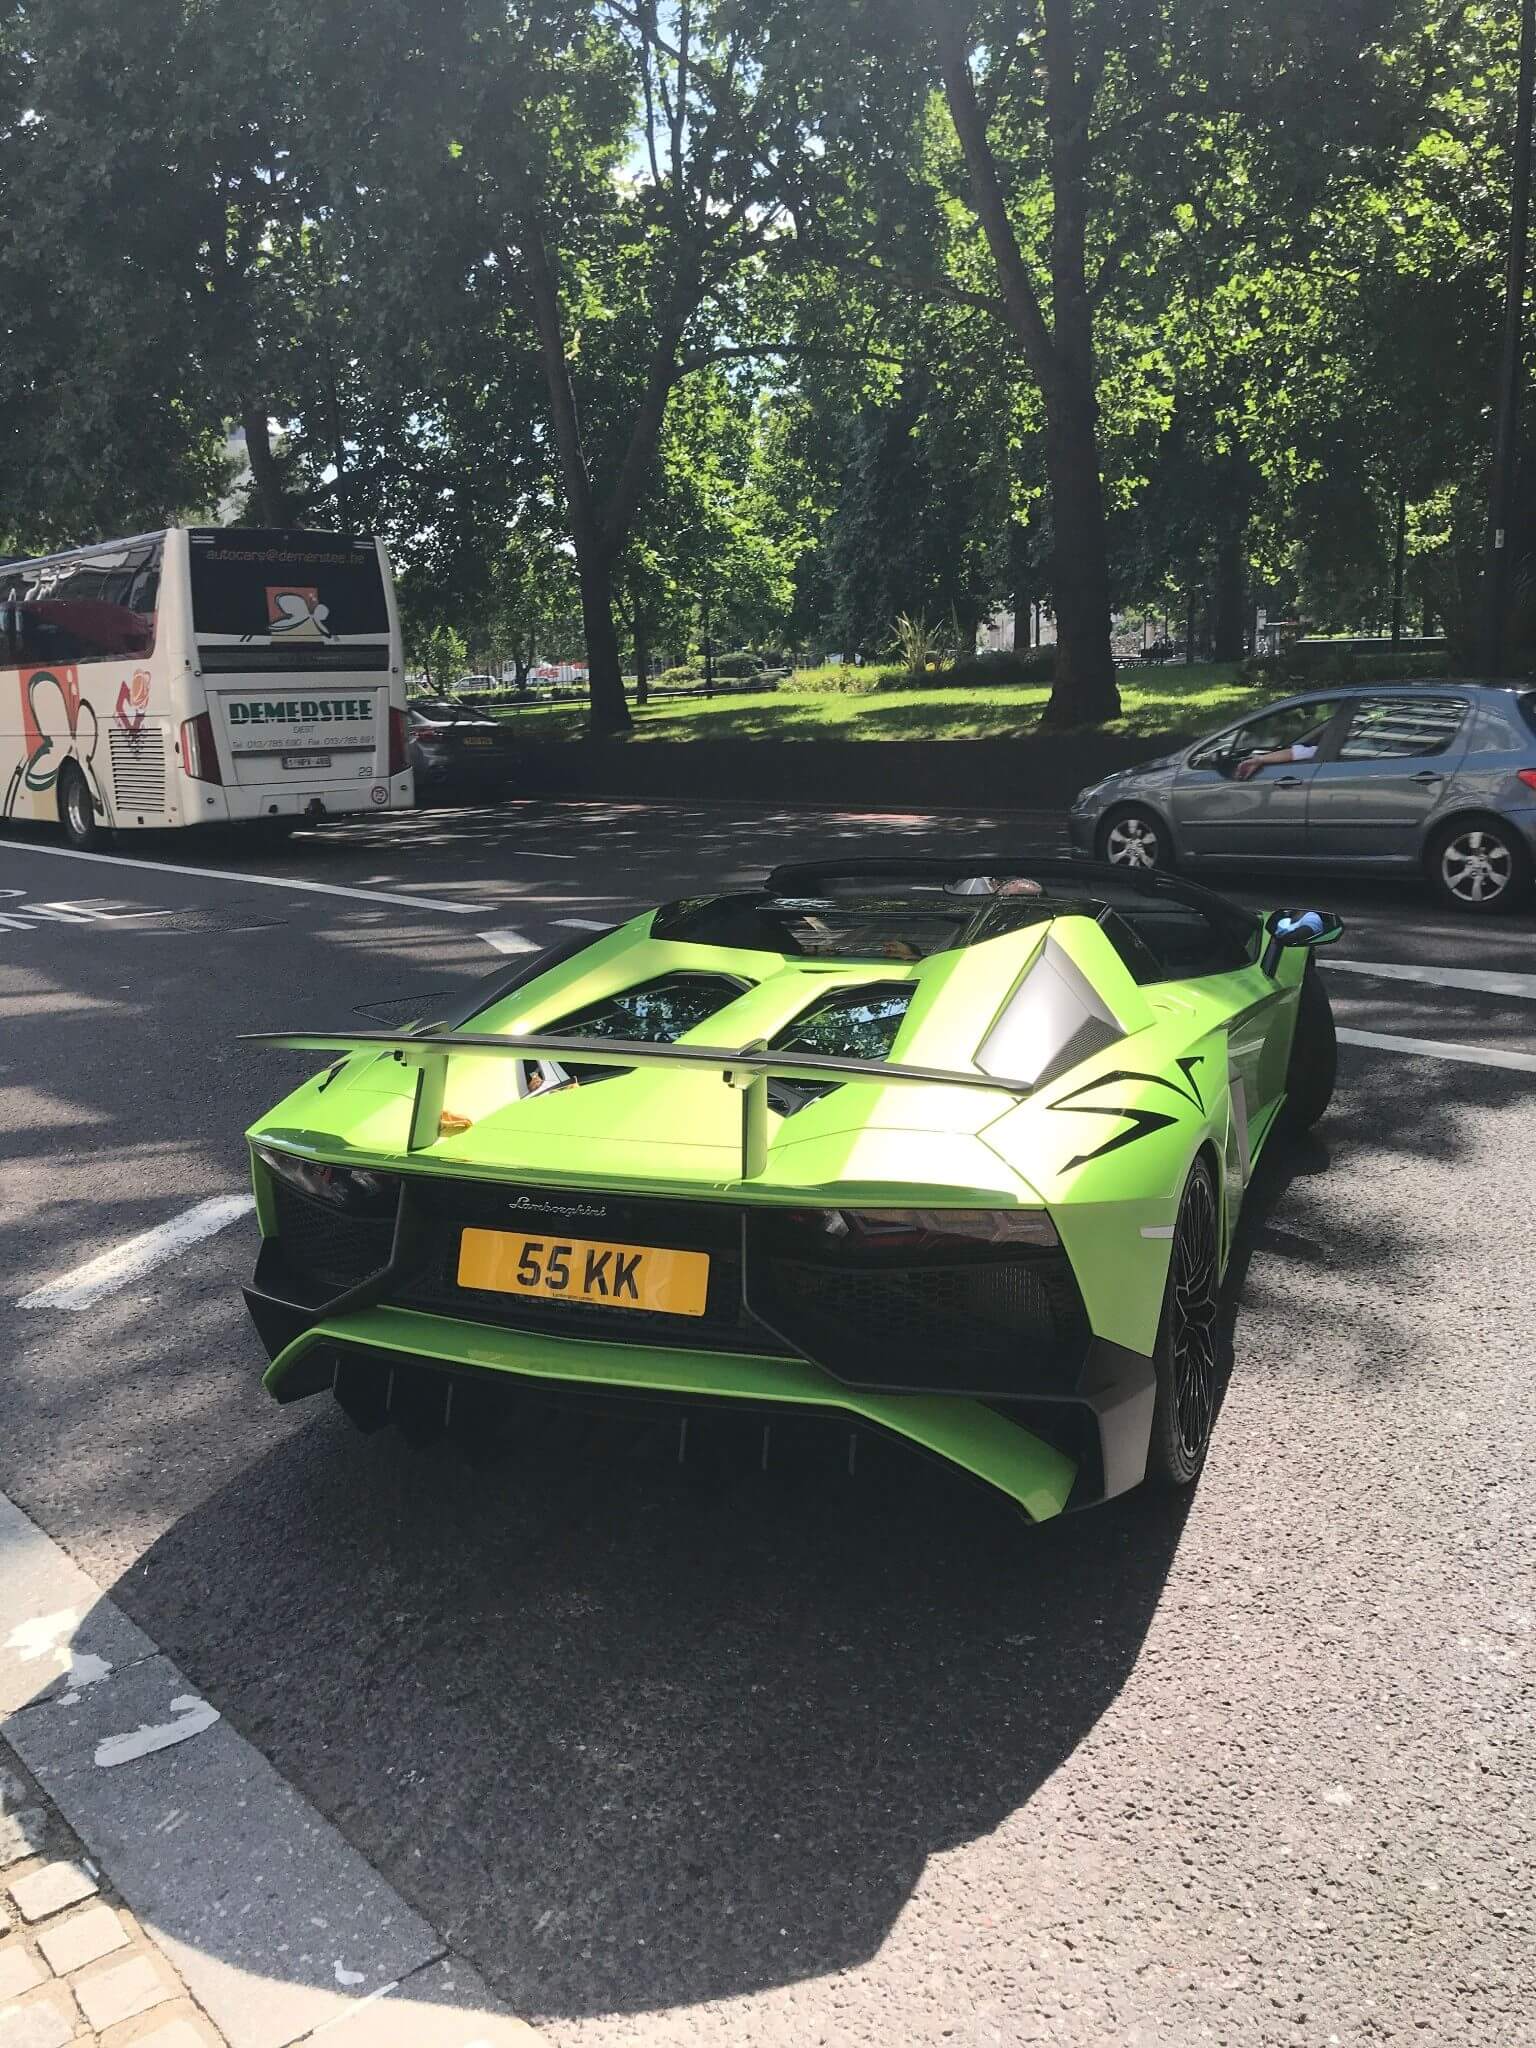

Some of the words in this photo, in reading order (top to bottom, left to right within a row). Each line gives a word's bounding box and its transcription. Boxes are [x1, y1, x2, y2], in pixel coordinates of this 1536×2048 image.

[229, 700, 373, 725] DEMERSTEE
[359, 766, 373, 777] 29
[508, 1196, 608, 1219] Lamborghini
[516, 1242, 573, 1290] 55
[583, 1248, 643, 1300] KK
